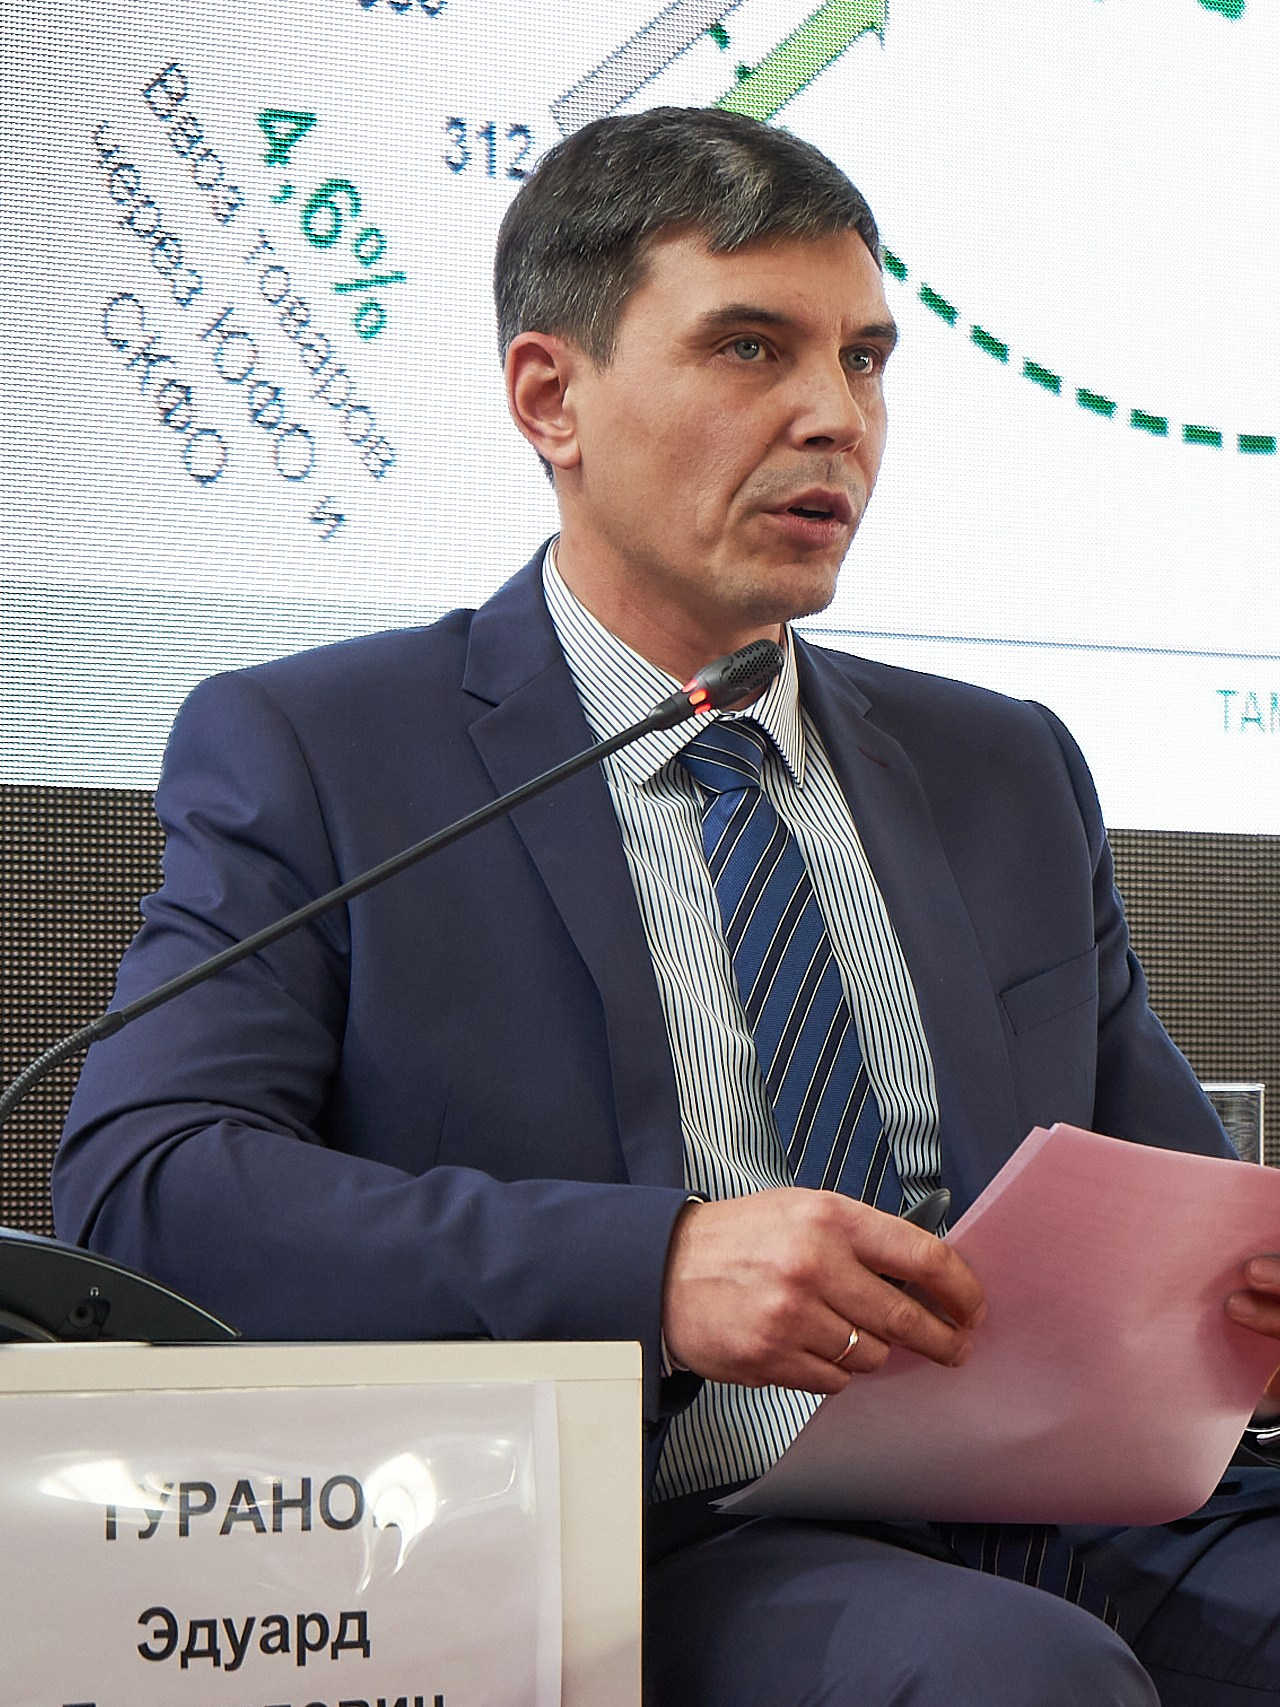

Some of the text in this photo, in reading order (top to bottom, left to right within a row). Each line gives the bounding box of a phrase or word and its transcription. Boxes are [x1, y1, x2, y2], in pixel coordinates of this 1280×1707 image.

[258, 108, 407, 340] 4,6%
[443, 116, 534, 180] 312
[94, 121, 348, 541] через ЮФО и
[143, 62, 396, 479] Ввоз товаров
[103, 293, 228, 487] СКФО
[104, 1474, 402, 1541] УРАНО
[137, 1606, 371, 1671] Эдуард
